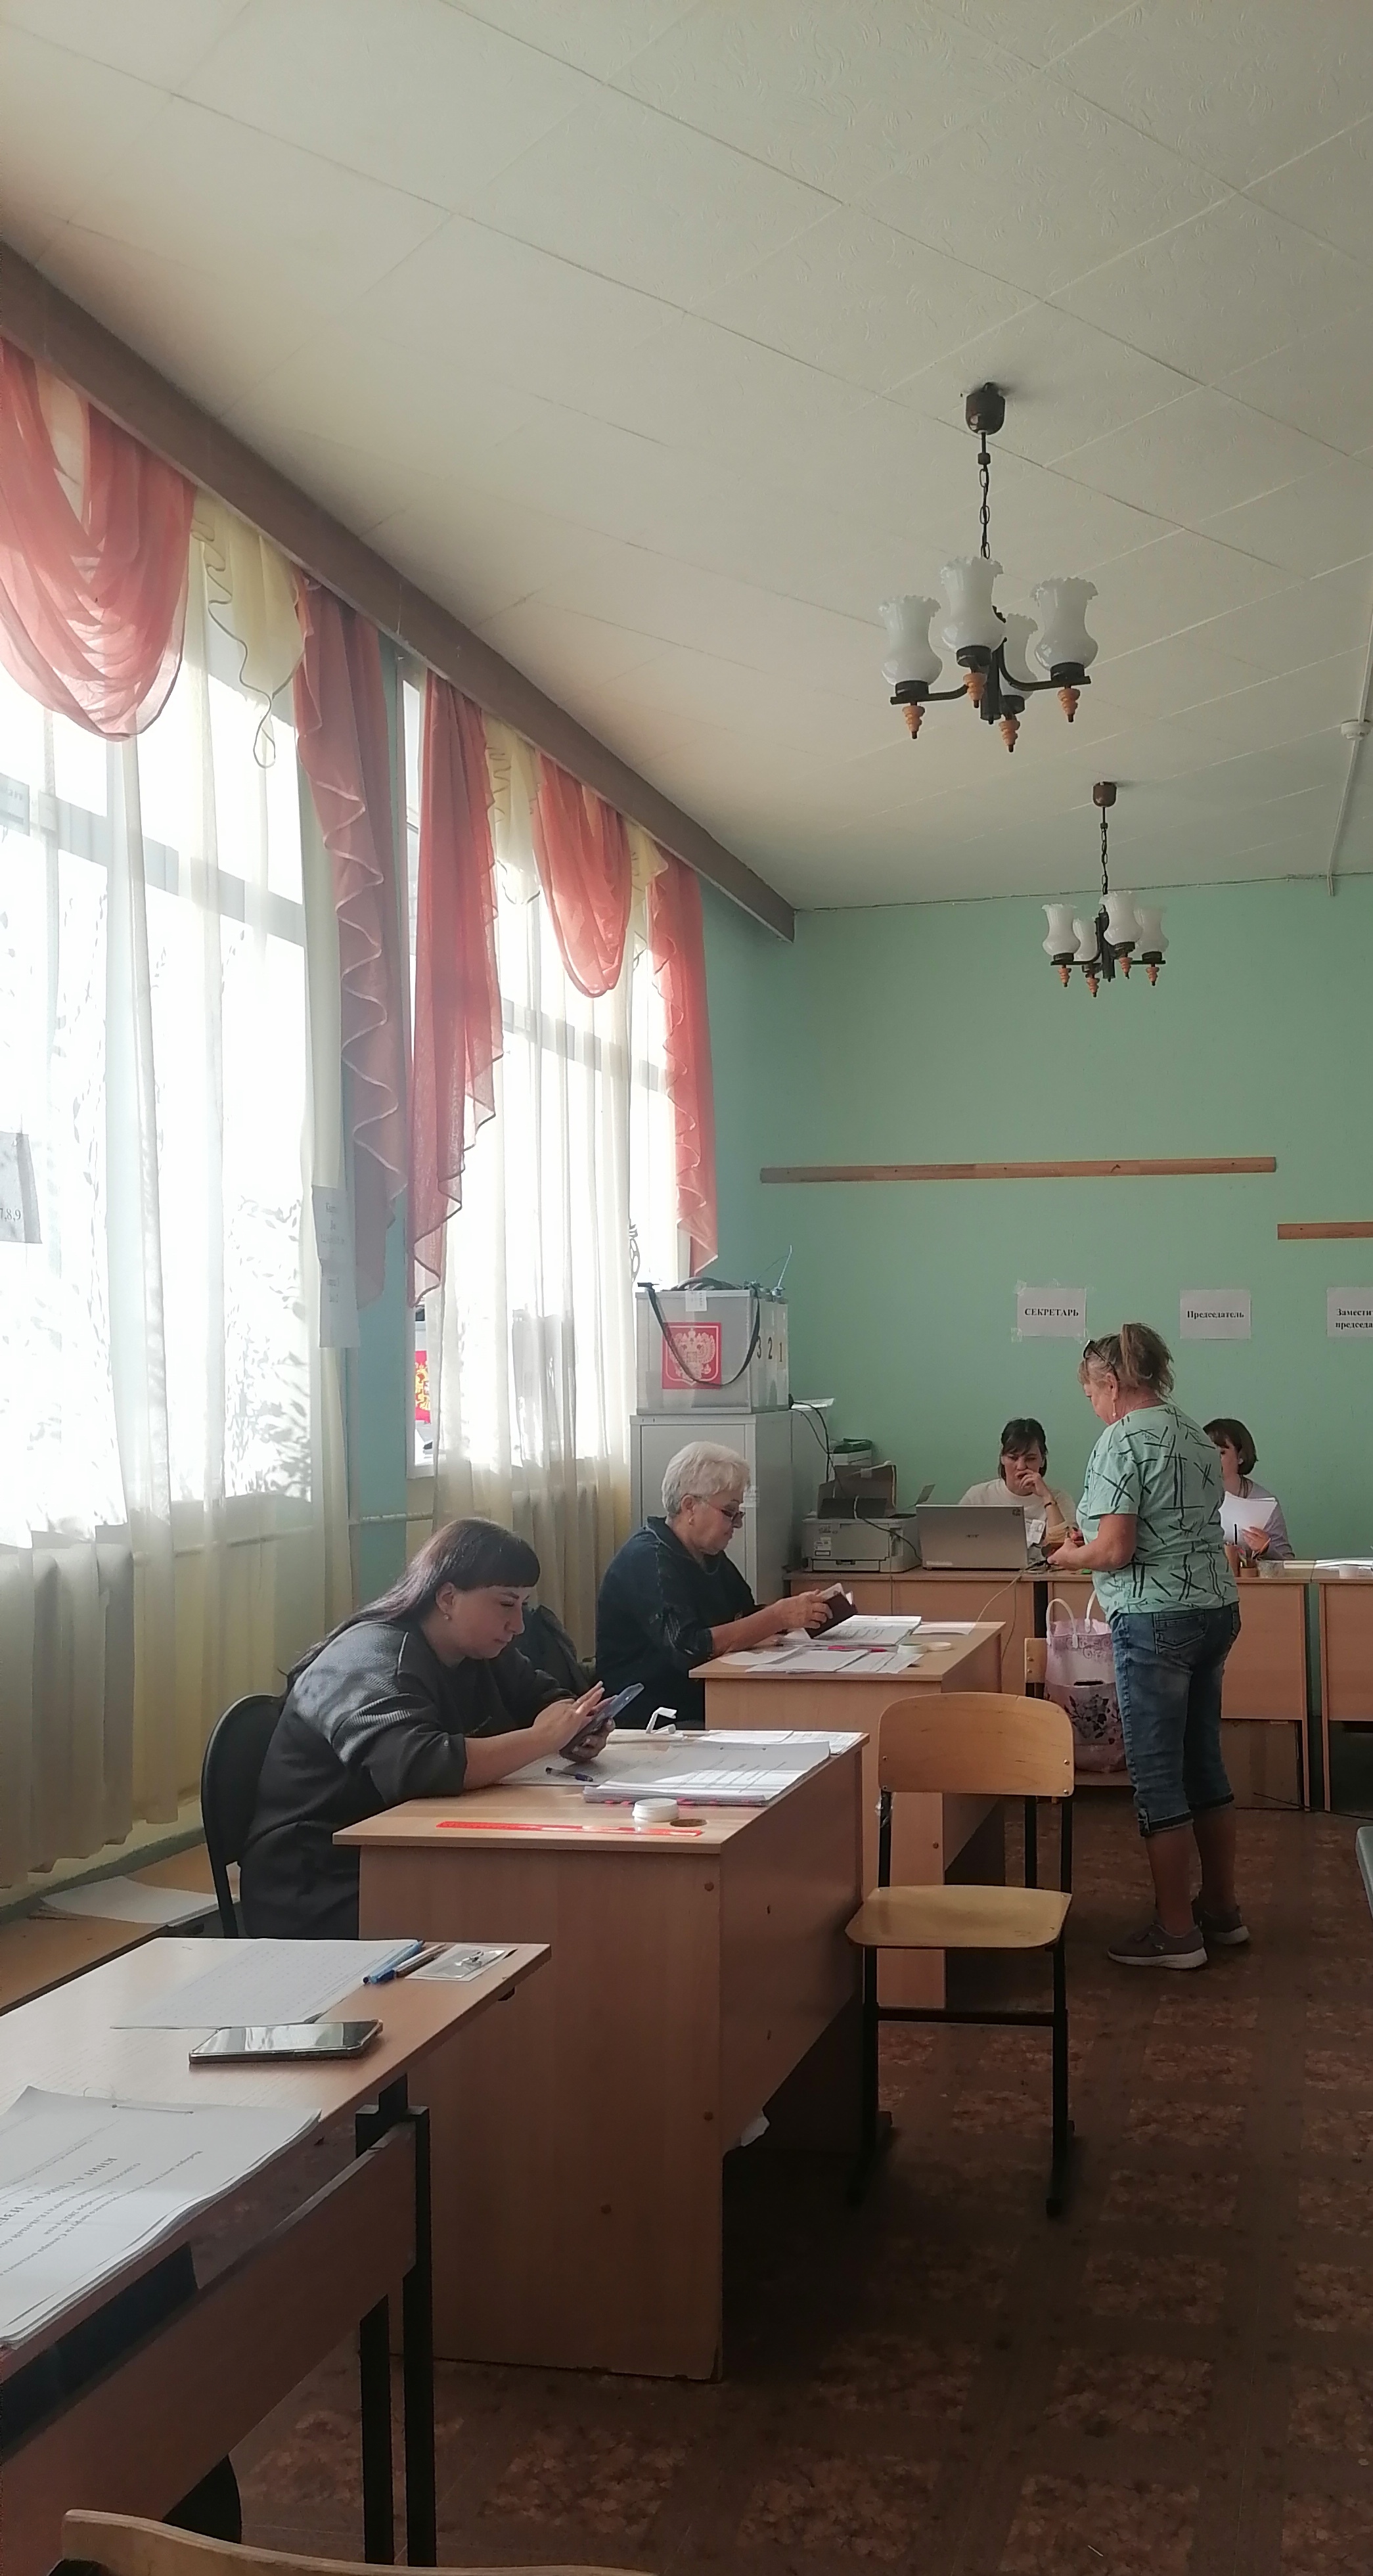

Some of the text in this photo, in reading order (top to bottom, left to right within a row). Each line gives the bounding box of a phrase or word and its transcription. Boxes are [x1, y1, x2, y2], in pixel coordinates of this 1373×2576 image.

[1024, 1308, 1079, 1317] СЕКРЕТАРЬ
[1186, 1310, 1245, 1320] Председатель
[1336, 1308, 1373, 1317] Замести
[74, 2157, 118, 2182] КНИГА
[21, 2181, 76, 2205] СПИСКА
